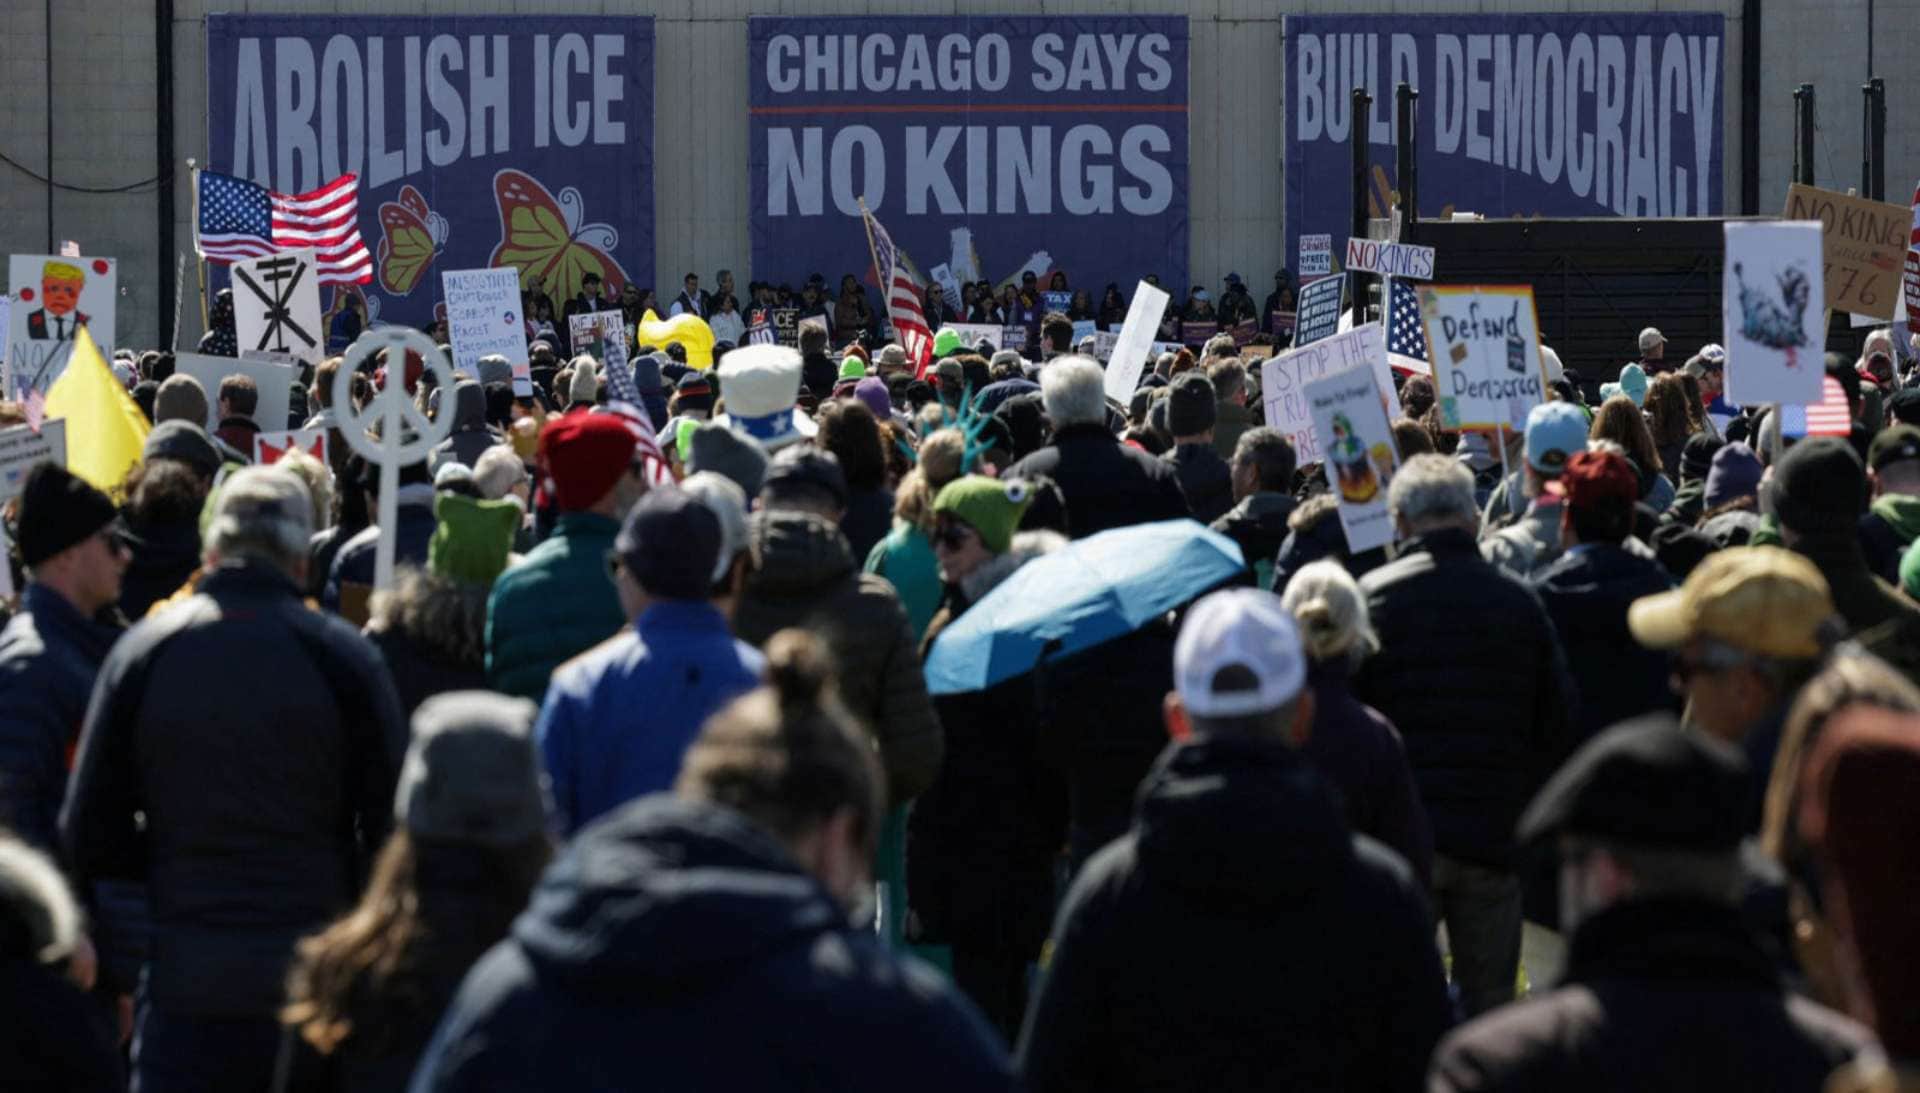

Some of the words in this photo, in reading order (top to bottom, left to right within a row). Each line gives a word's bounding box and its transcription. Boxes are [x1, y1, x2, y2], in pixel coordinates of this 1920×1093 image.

[766, 33, 1011, 93] CHICAGO
[1031, 33, 1173, 92] SAYS
[233, 33, 510, 195] ABOLISH
[533, 33, 626, 148] ICE
[1434, 32, 1720, 218] DEMOCRACY
[767, 124, 886, 217] NO
[904, 124, 1174, 217] KINGS
[1049, 292, 1072, 304] TAX
[1441, 299, 1519, 344] Defend
[1276, 343, 1330, 391] STOP
